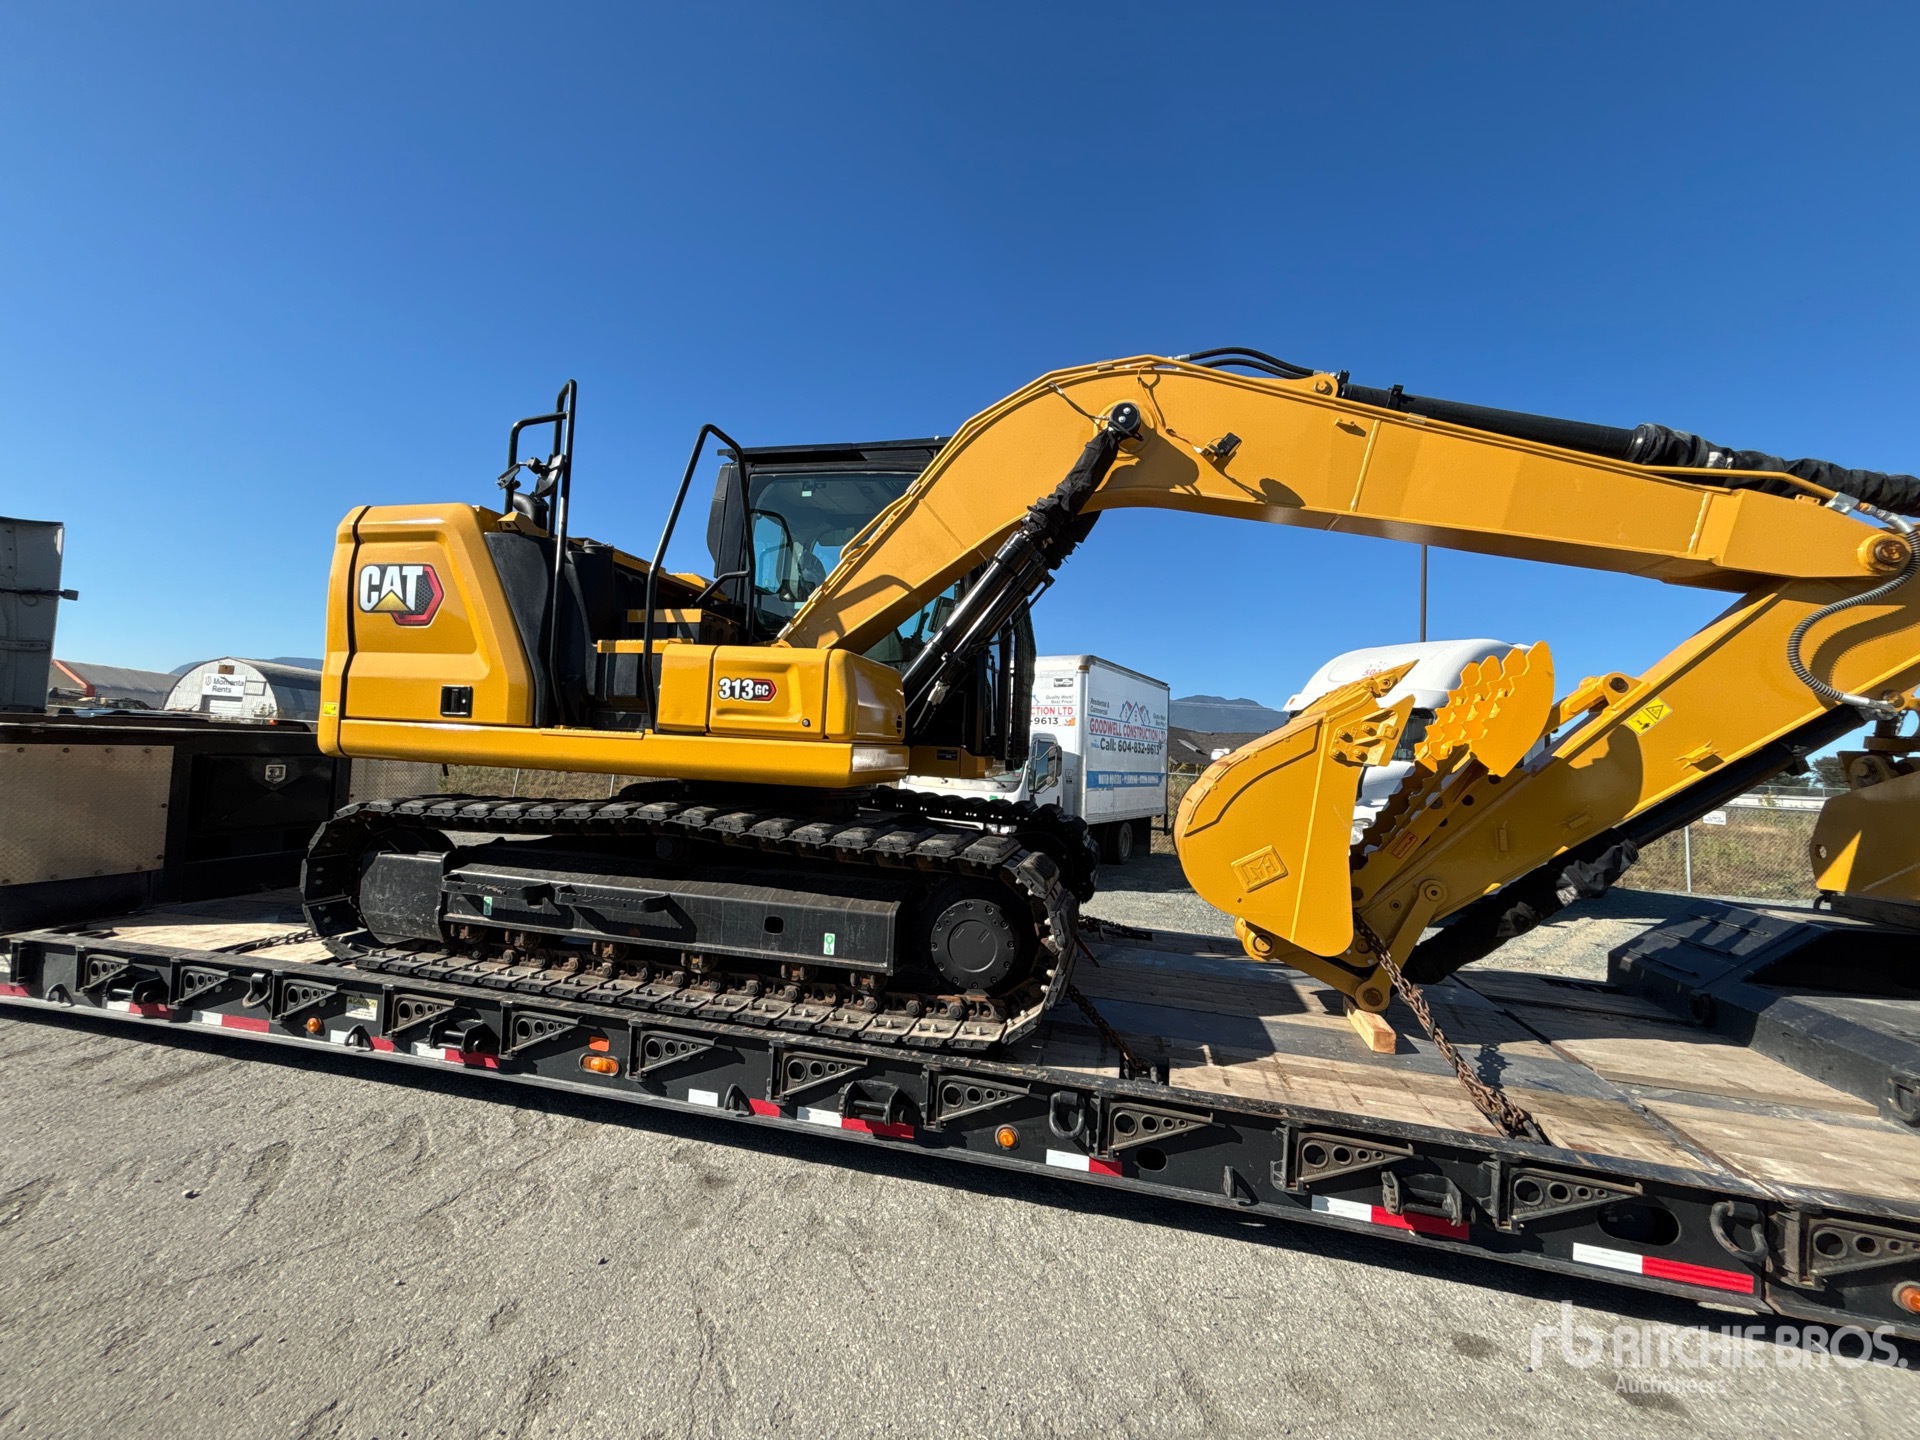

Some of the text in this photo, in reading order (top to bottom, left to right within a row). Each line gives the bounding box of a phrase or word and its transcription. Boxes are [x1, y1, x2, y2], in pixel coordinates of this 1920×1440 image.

[360, 565, 424, 611] CAT
[212, 685, 232, 693] Rents
[718, 677, 769, 700] 313 GC
[1057, 706, 1074, 716] LTD
[1090, 718, 1122, 736] GOODWELL
[1123, 724, 1158, 742] CONSTRUCTION
[1100, 737, 1117, 752] Call:
[1118, 740, 1160, 756] 604-832-9613
